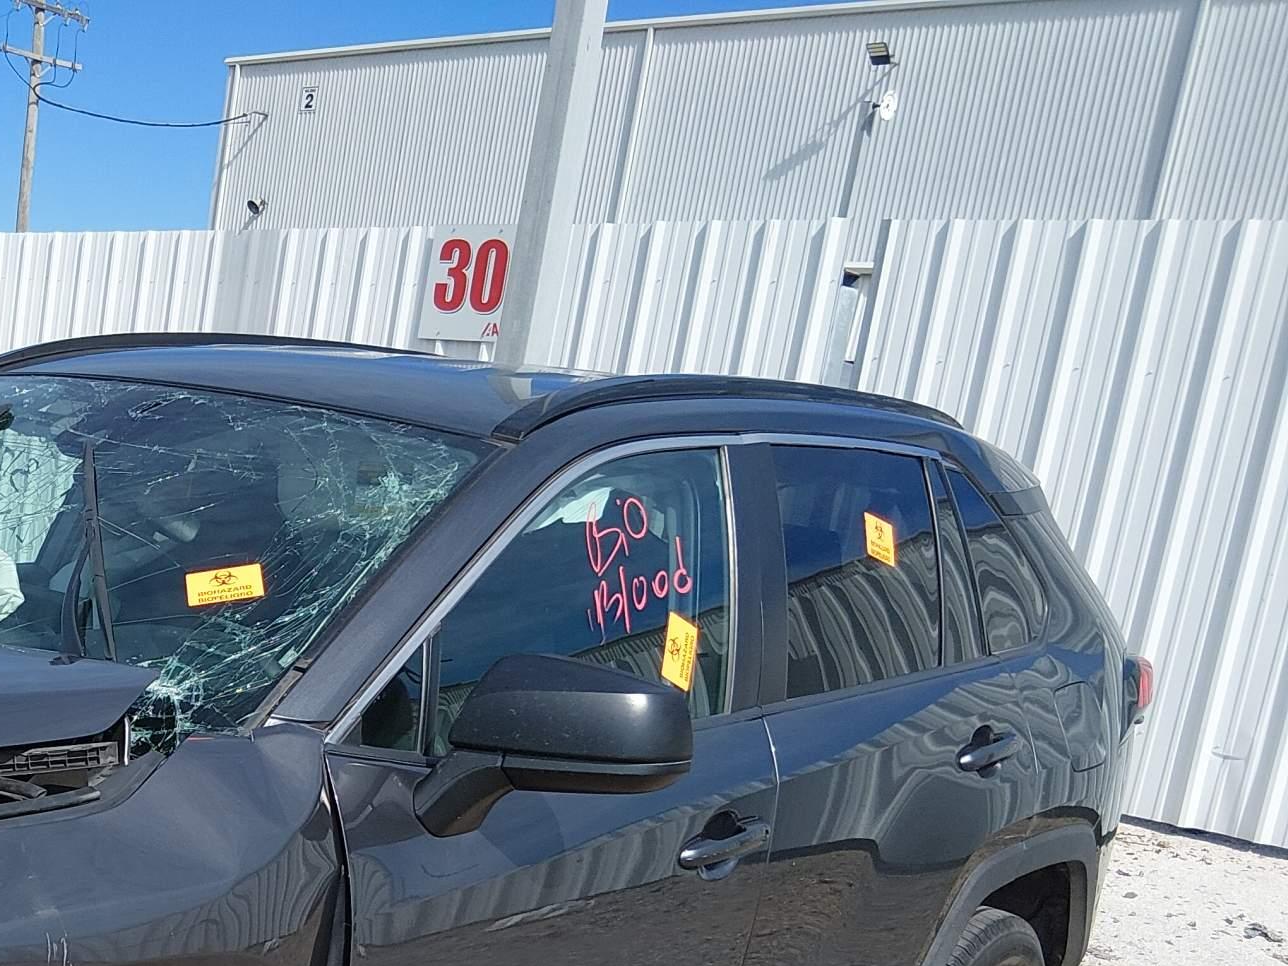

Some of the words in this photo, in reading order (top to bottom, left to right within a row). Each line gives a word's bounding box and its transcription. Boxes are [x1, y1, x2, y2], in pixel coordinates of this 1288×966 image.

[304, 93, 314, 109] 2
[432, 237, 510, 315] 30
[197, 584, 253, 597] BIOHAZARD
[197, 590, 254, 603] BIOPELIGRO
[591, 536, 692, 644] Blood
